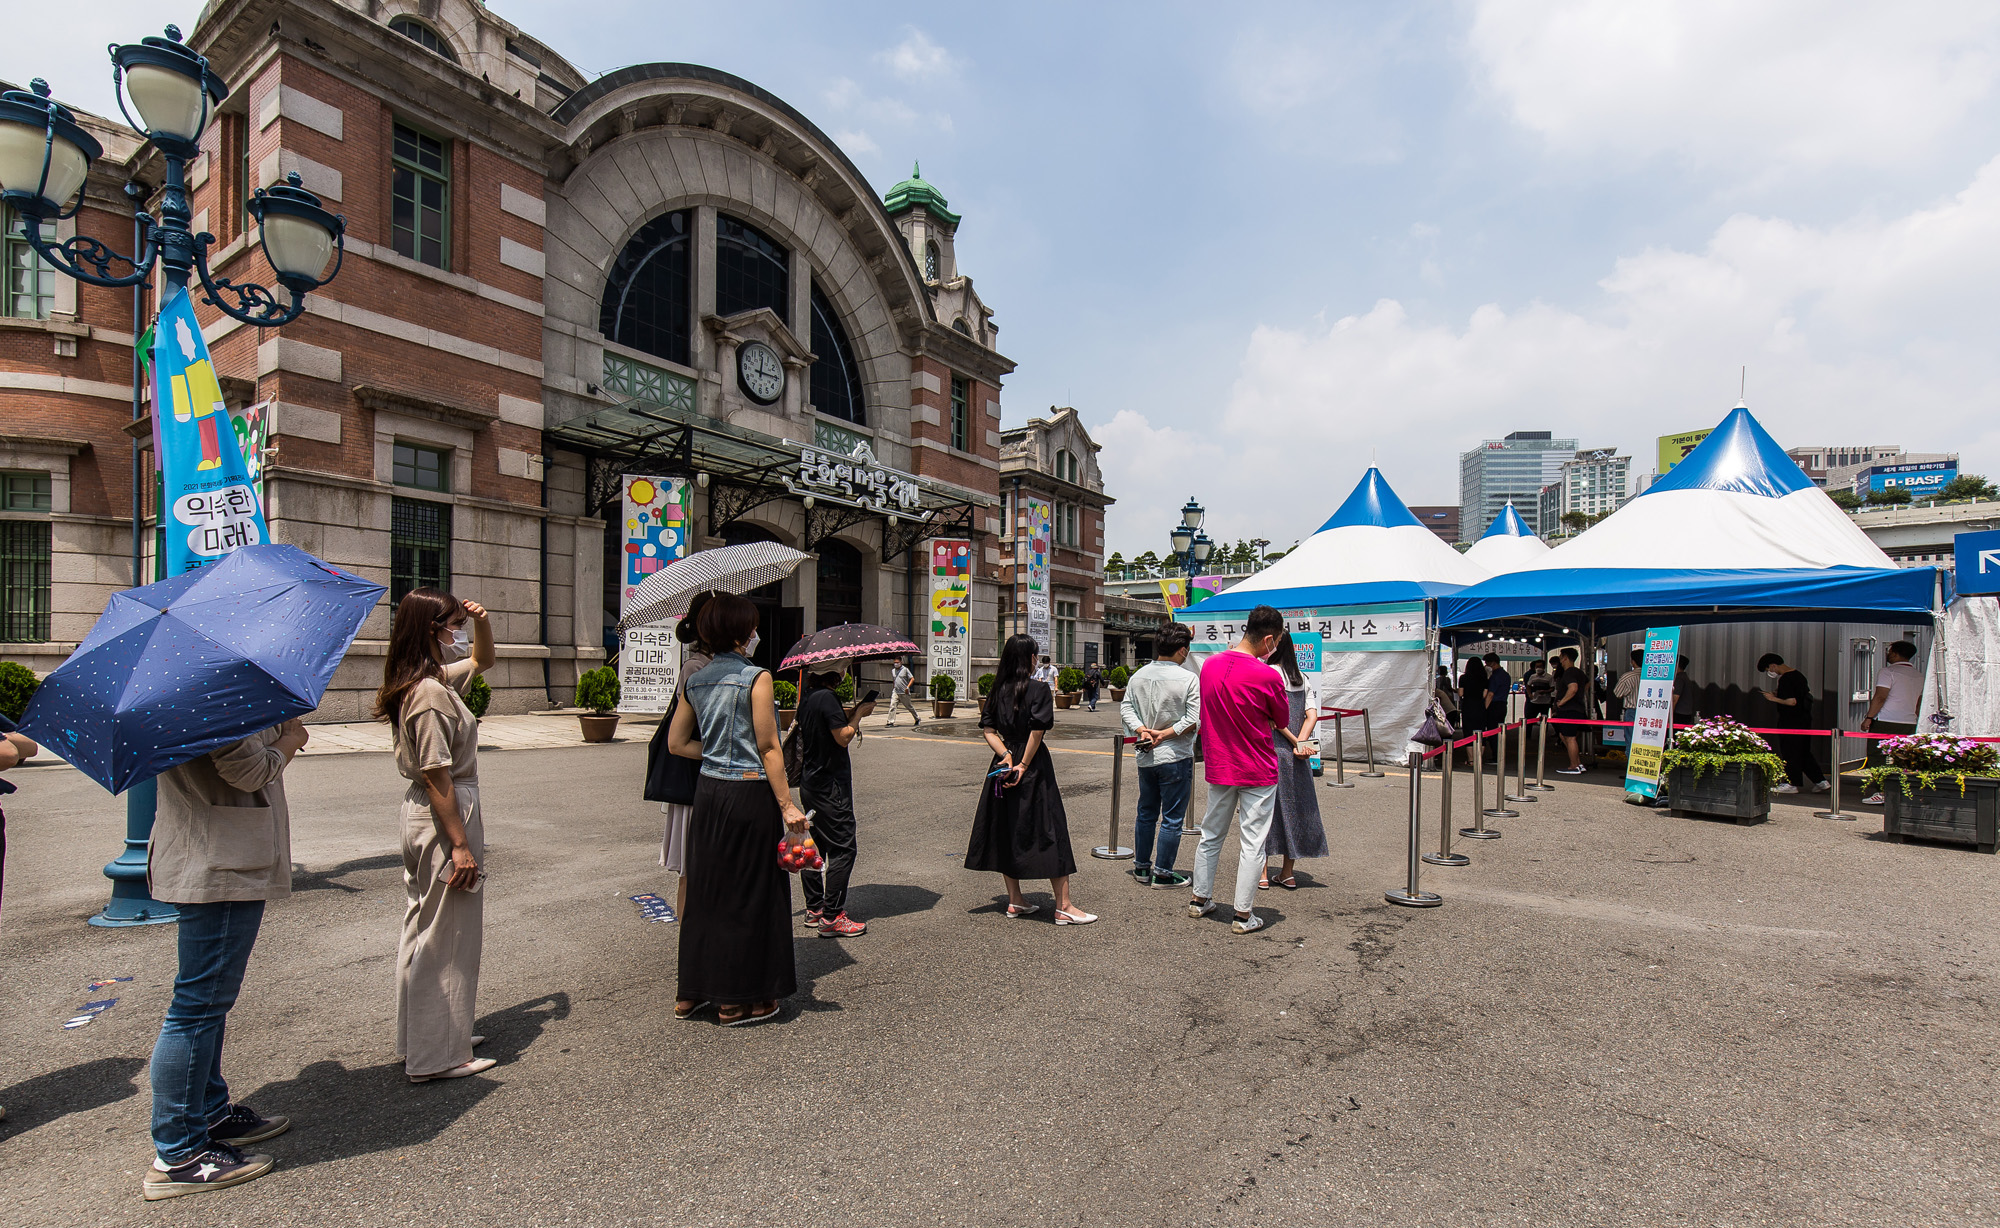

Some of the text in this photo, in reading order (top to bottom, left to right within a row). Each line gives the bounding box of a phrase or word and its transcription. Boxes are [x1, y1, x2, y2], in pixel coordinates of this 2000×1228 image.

[1671, 435, 1693, 445] 기본이
[1487, 442, 1504, 450] AIA
[1898, 464, 1918, 472] 제일의
[1919, 462, 1946, 470] 화학기업
[1904, 475, 1944, 486] BASF
[183, 483, 199, 491] 2021
[186, 488, 252, 521] 익숙한
[204, 521, 254, 551] 미래:
[1030, 596, 1048, 609] 익숙한
[629, 631, 673, 647] 익숙한
[933, 645, 962, 656] 익숙한
[1650, 640, 1673, 651] 코로나19
[635, 649, 667, 664] 미래:
[1645, 652, 1674, 664] 중구선별검사소
[625, 666, 675, 676] 공공디자인이
[1647, 666, 1669, 677] 운영시간
[624, 676, 675, 686] 추구하는 가치
